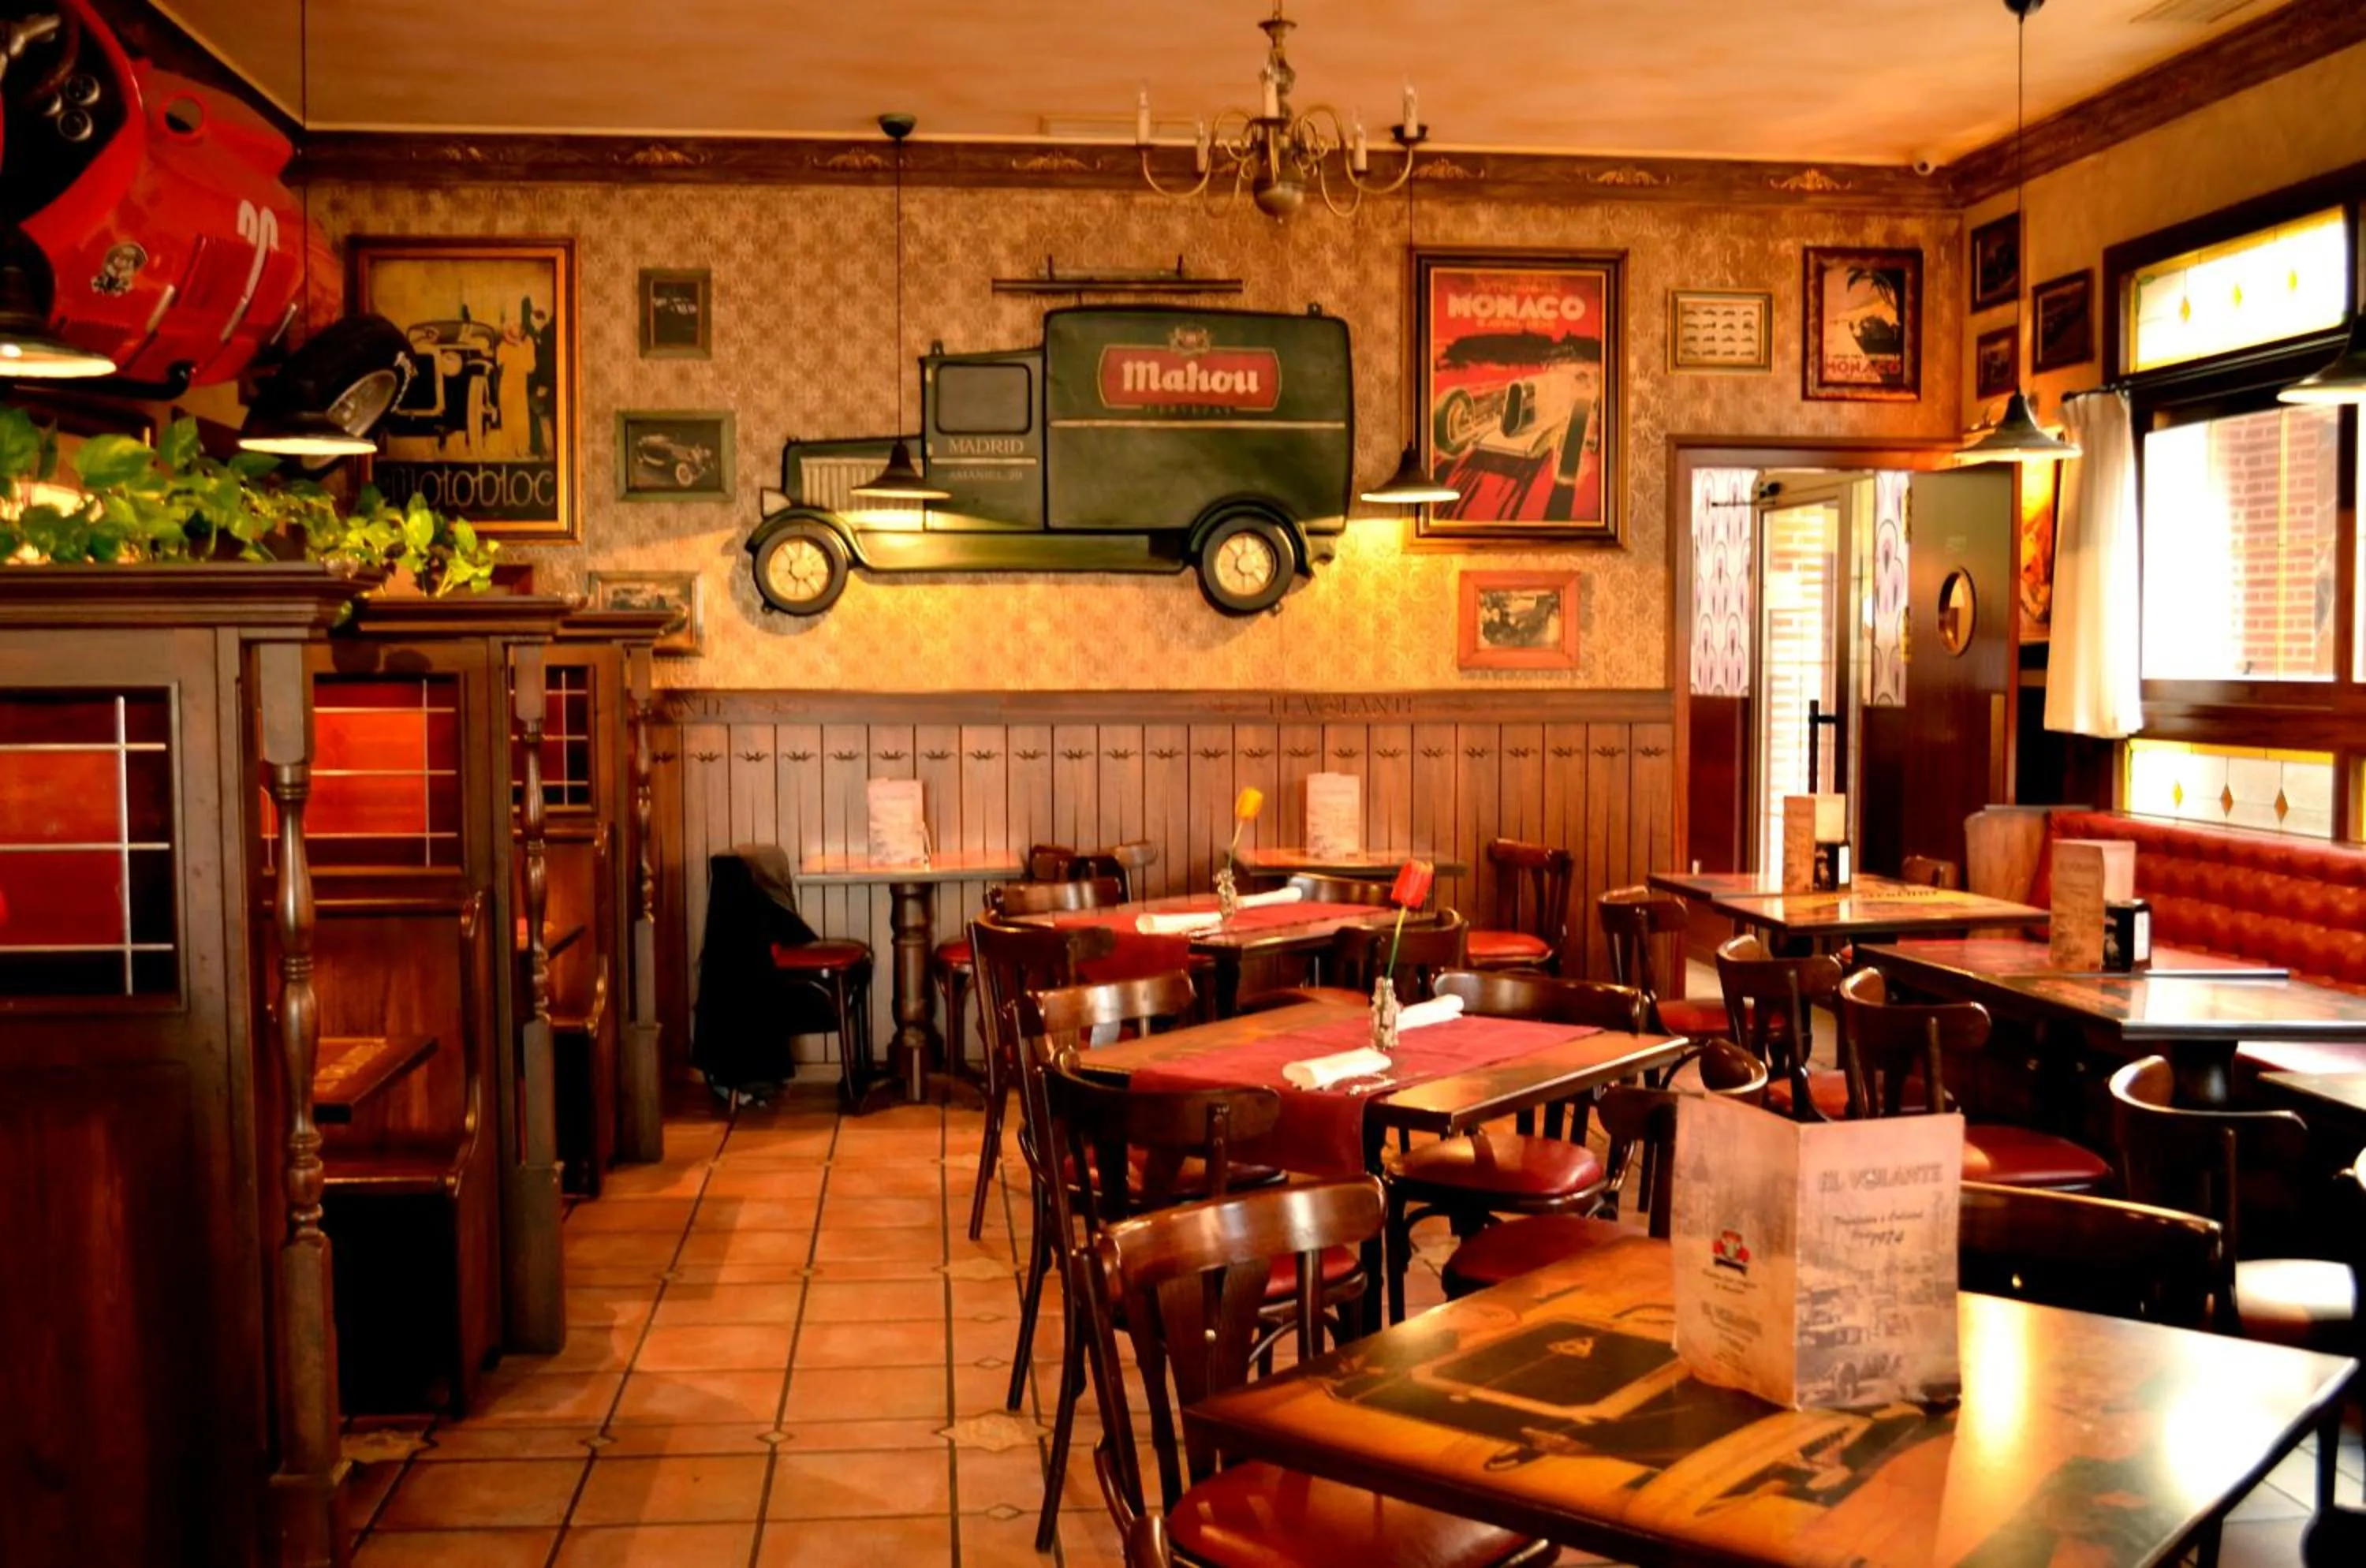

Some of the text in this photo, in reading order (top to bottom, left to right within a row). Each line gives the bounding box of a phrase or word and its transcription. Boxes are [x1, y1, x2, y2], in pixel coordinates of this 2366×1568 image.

[1448, 293, 1585, 321] MONACO
[1122, 360, 1260, 394] Mahou
[1827, 361, 1901, 375] MONACO
[949, 439, 1024, 454] MADRID
